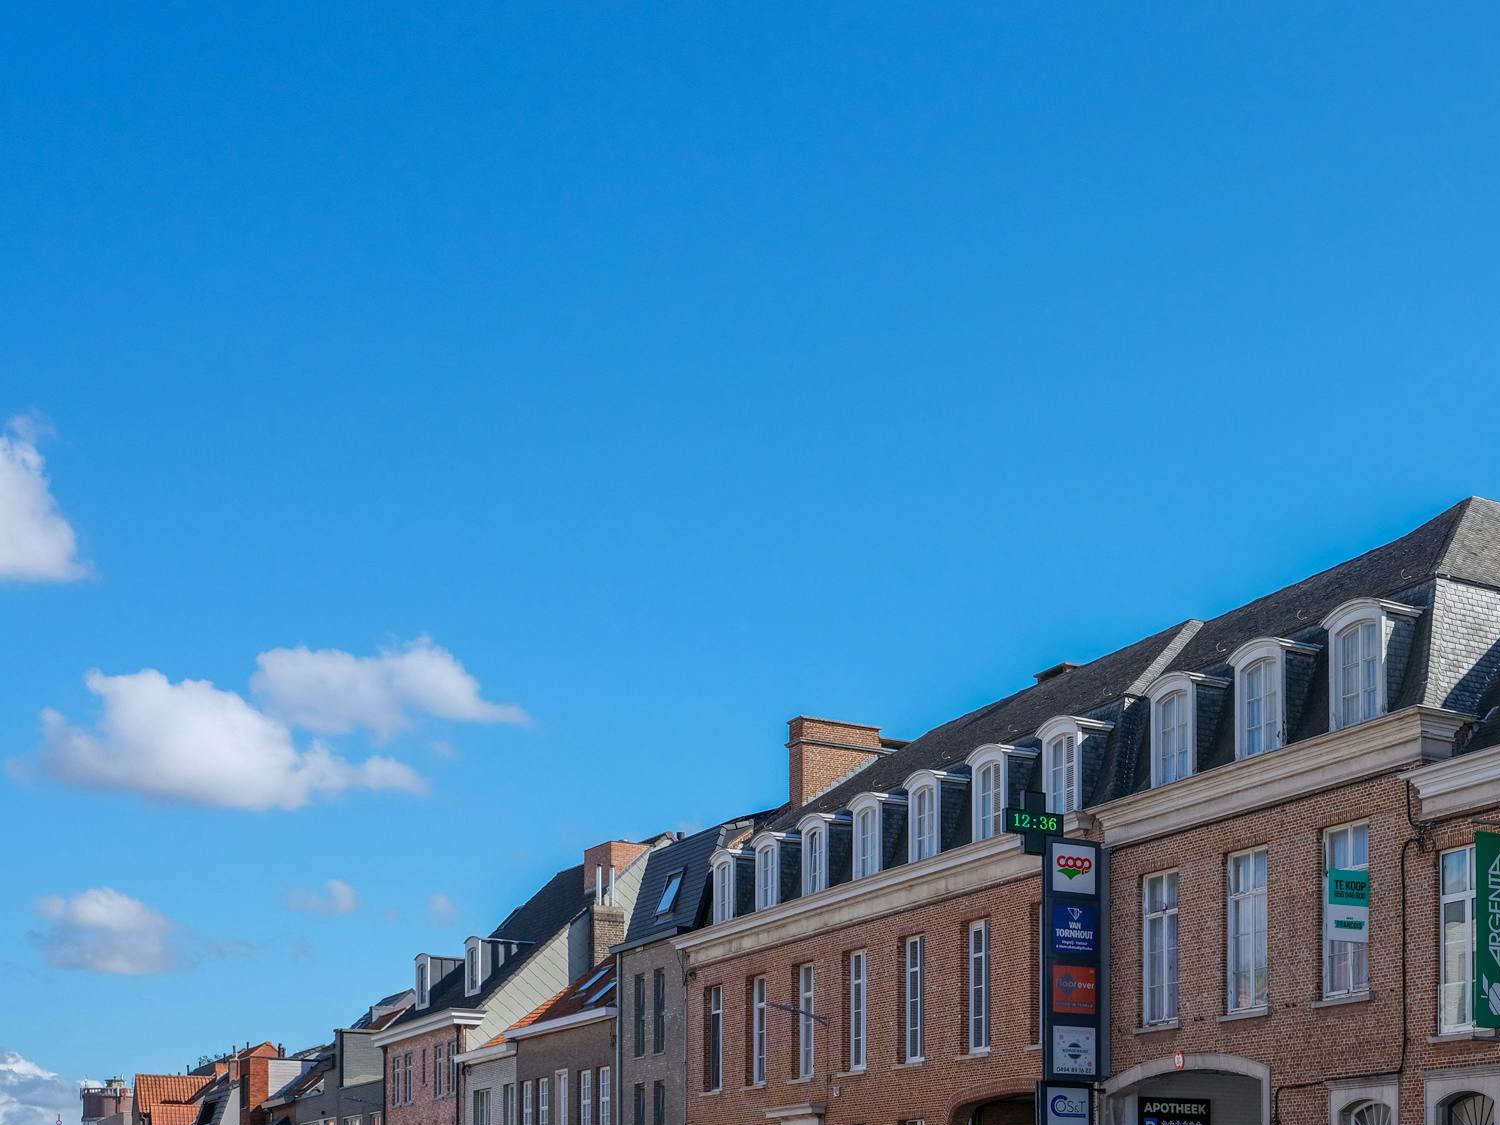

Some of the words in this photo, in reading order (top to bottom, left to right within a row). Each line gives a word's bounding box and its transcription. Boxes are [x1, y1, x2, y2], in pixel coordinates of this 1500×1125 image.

[1014, 813, 1057, 831] 12:36
[1057, 855, 1092, 875] coop
[1334, 880, 1344, 890] TE
[1345, 881, 1366, 891] KOOP
[1069, 921, 1081, 930] VAN
[1056, 928, 1093, 940] TORNHOUT
[1144, 1103, 1206, 1114] APOTHEEK
